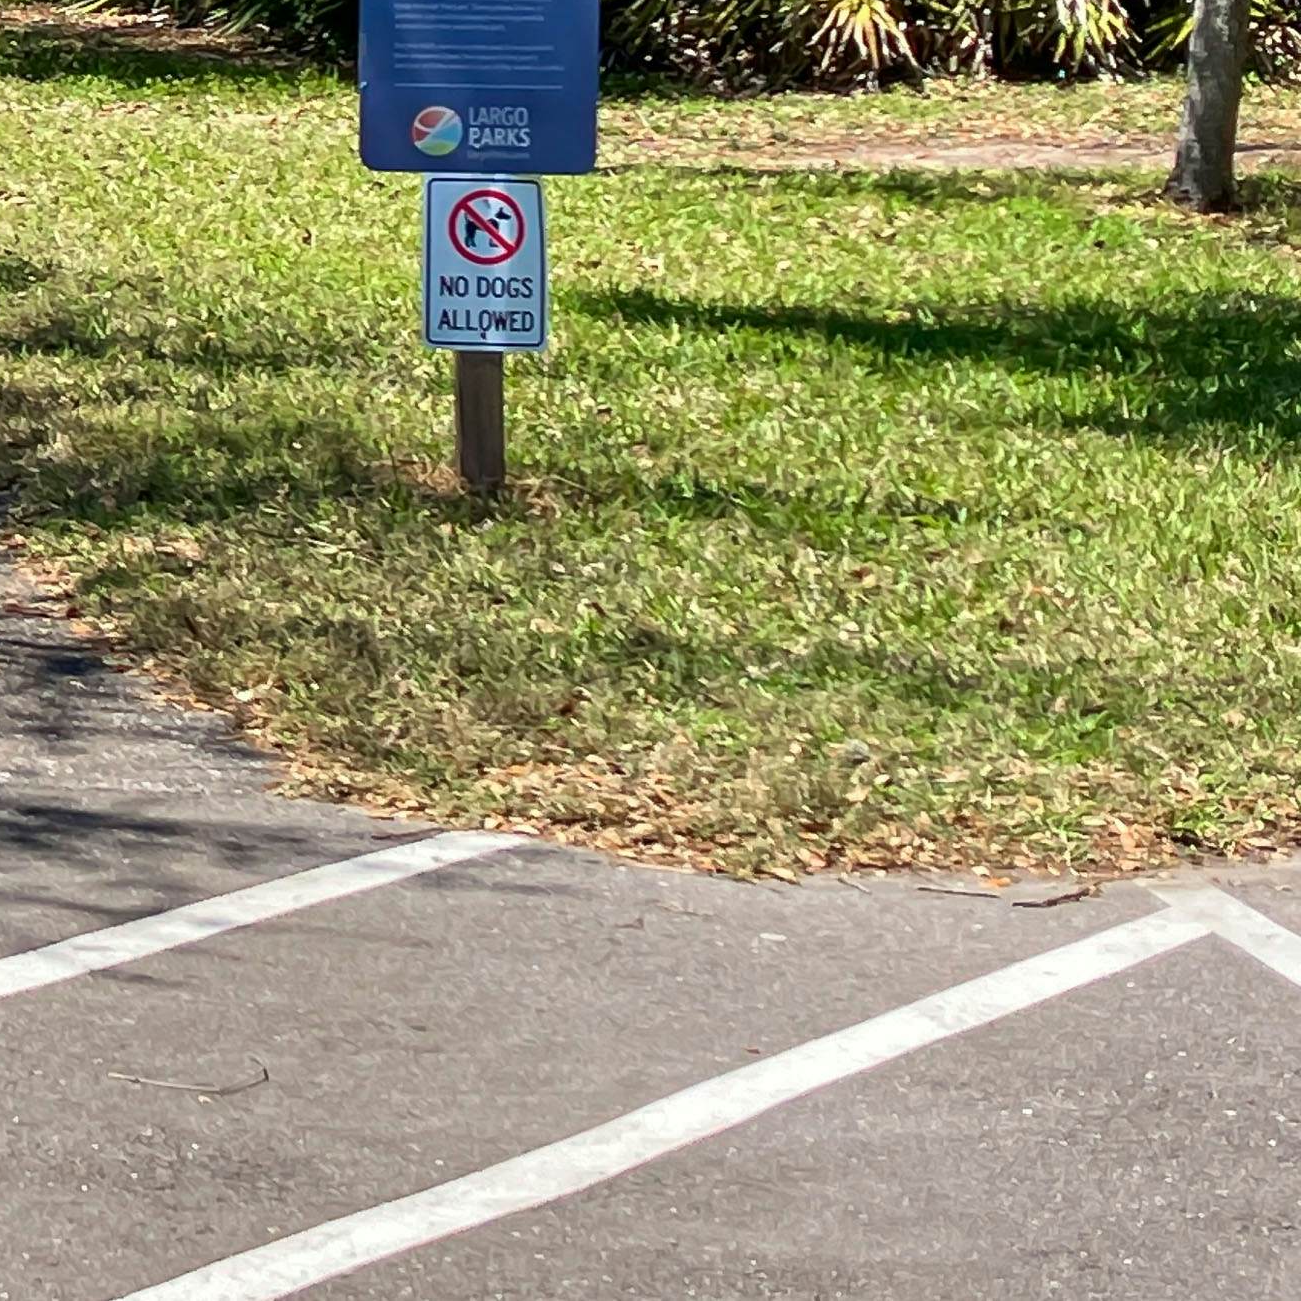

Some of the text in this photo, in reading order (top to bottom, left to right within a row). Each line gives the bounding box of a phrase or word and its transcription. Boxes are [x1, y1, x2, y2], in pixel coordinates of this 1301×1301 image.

[469, 107, 528, 125] LARGO
[468, 127, 531, 147] PARKS
[440, 275, 533, 298] NO DOGS
[437, 309, 534, 332] ALLOWED
